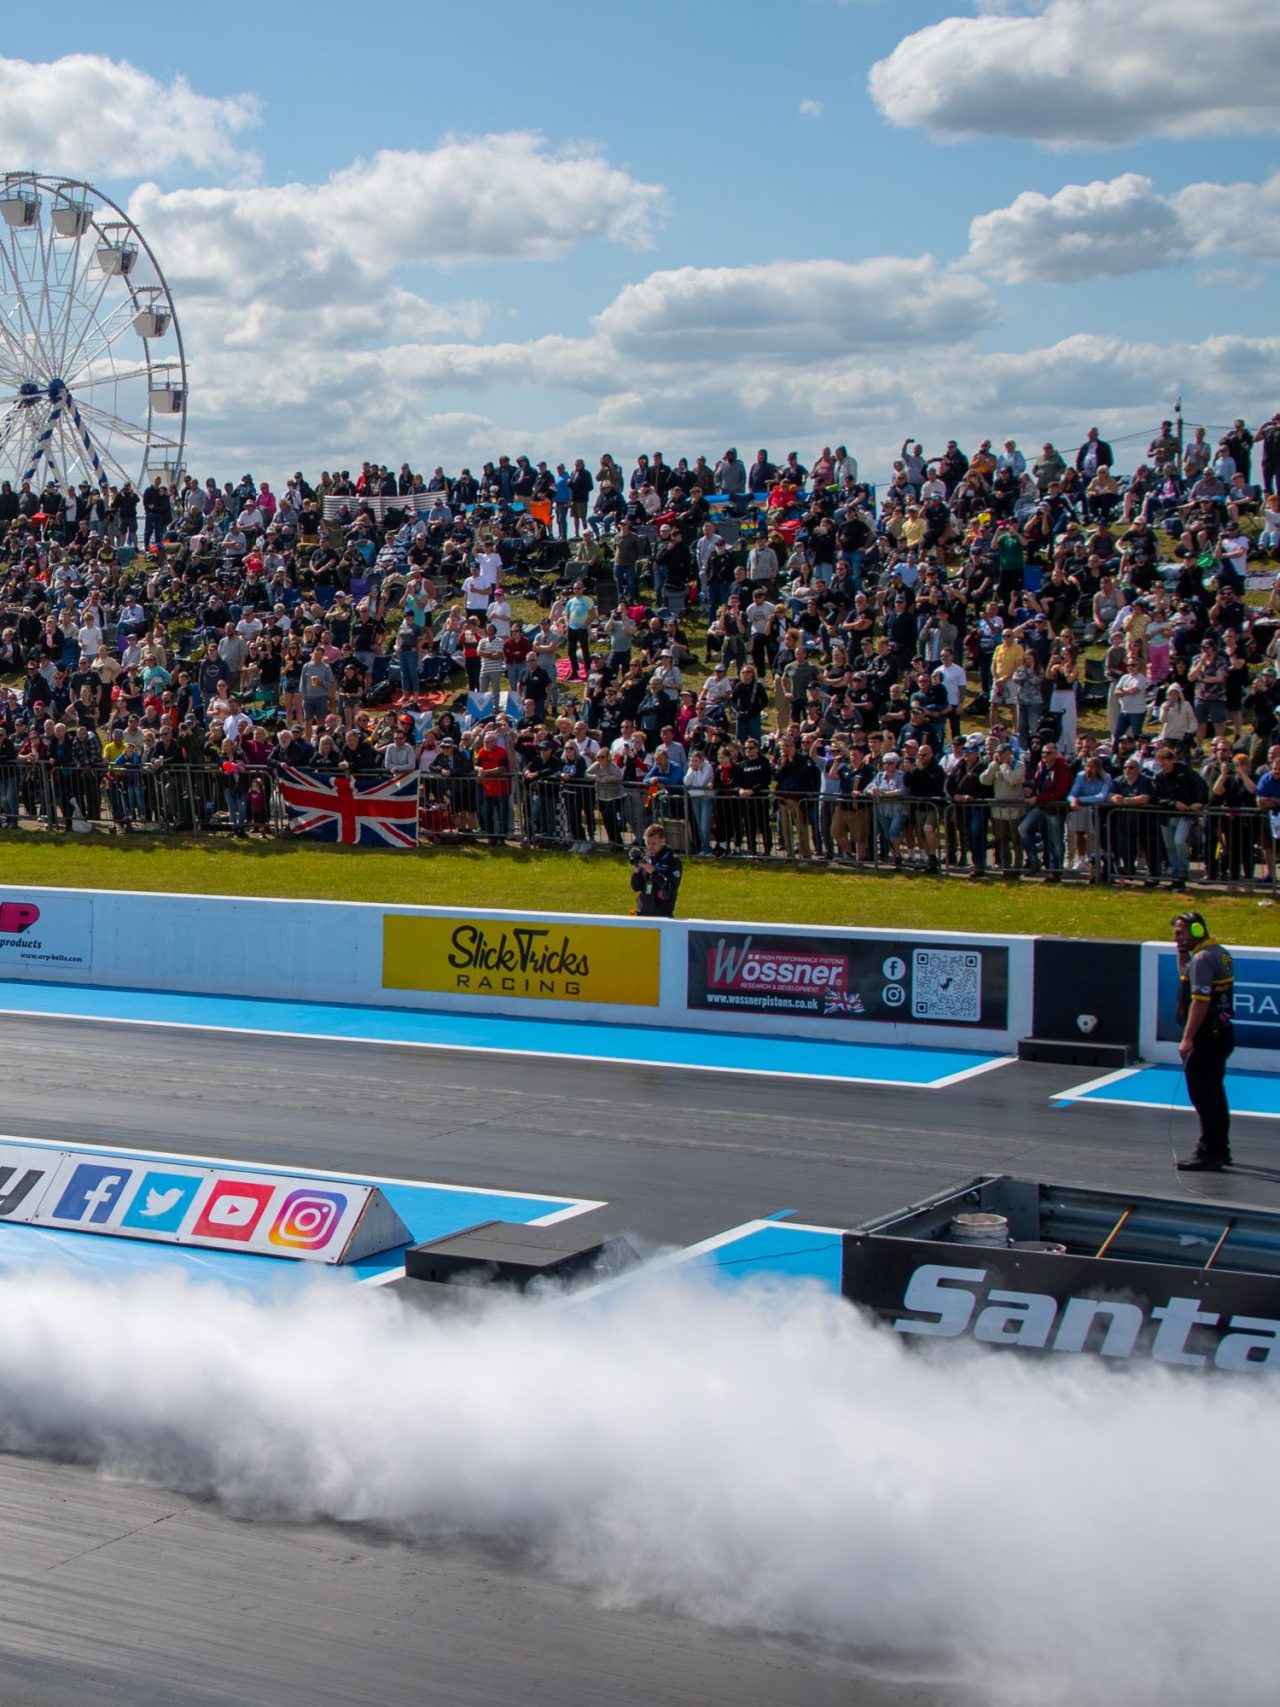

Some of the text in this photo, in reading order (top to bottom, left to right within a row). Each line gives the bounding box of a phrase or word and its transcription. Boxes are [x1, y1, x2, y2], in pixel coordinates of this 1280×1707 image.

[0, 937, 42, 950] products
[20, 952, 84, 963] www.arp-bolts.com
[775, 955, 819, 963] PERFORMANCE
[819, 957, 845, 965] PISTONS
[456, 974, 581, 996] RACING
[740, 982, 772, 990] RESEARCH
[777, 985, 819, 993] DEVELOPMENT
[706, 993, 819, 1010] www.wossnerpistons.co.uk
[893, 1263, 1280, 1373] Santa
